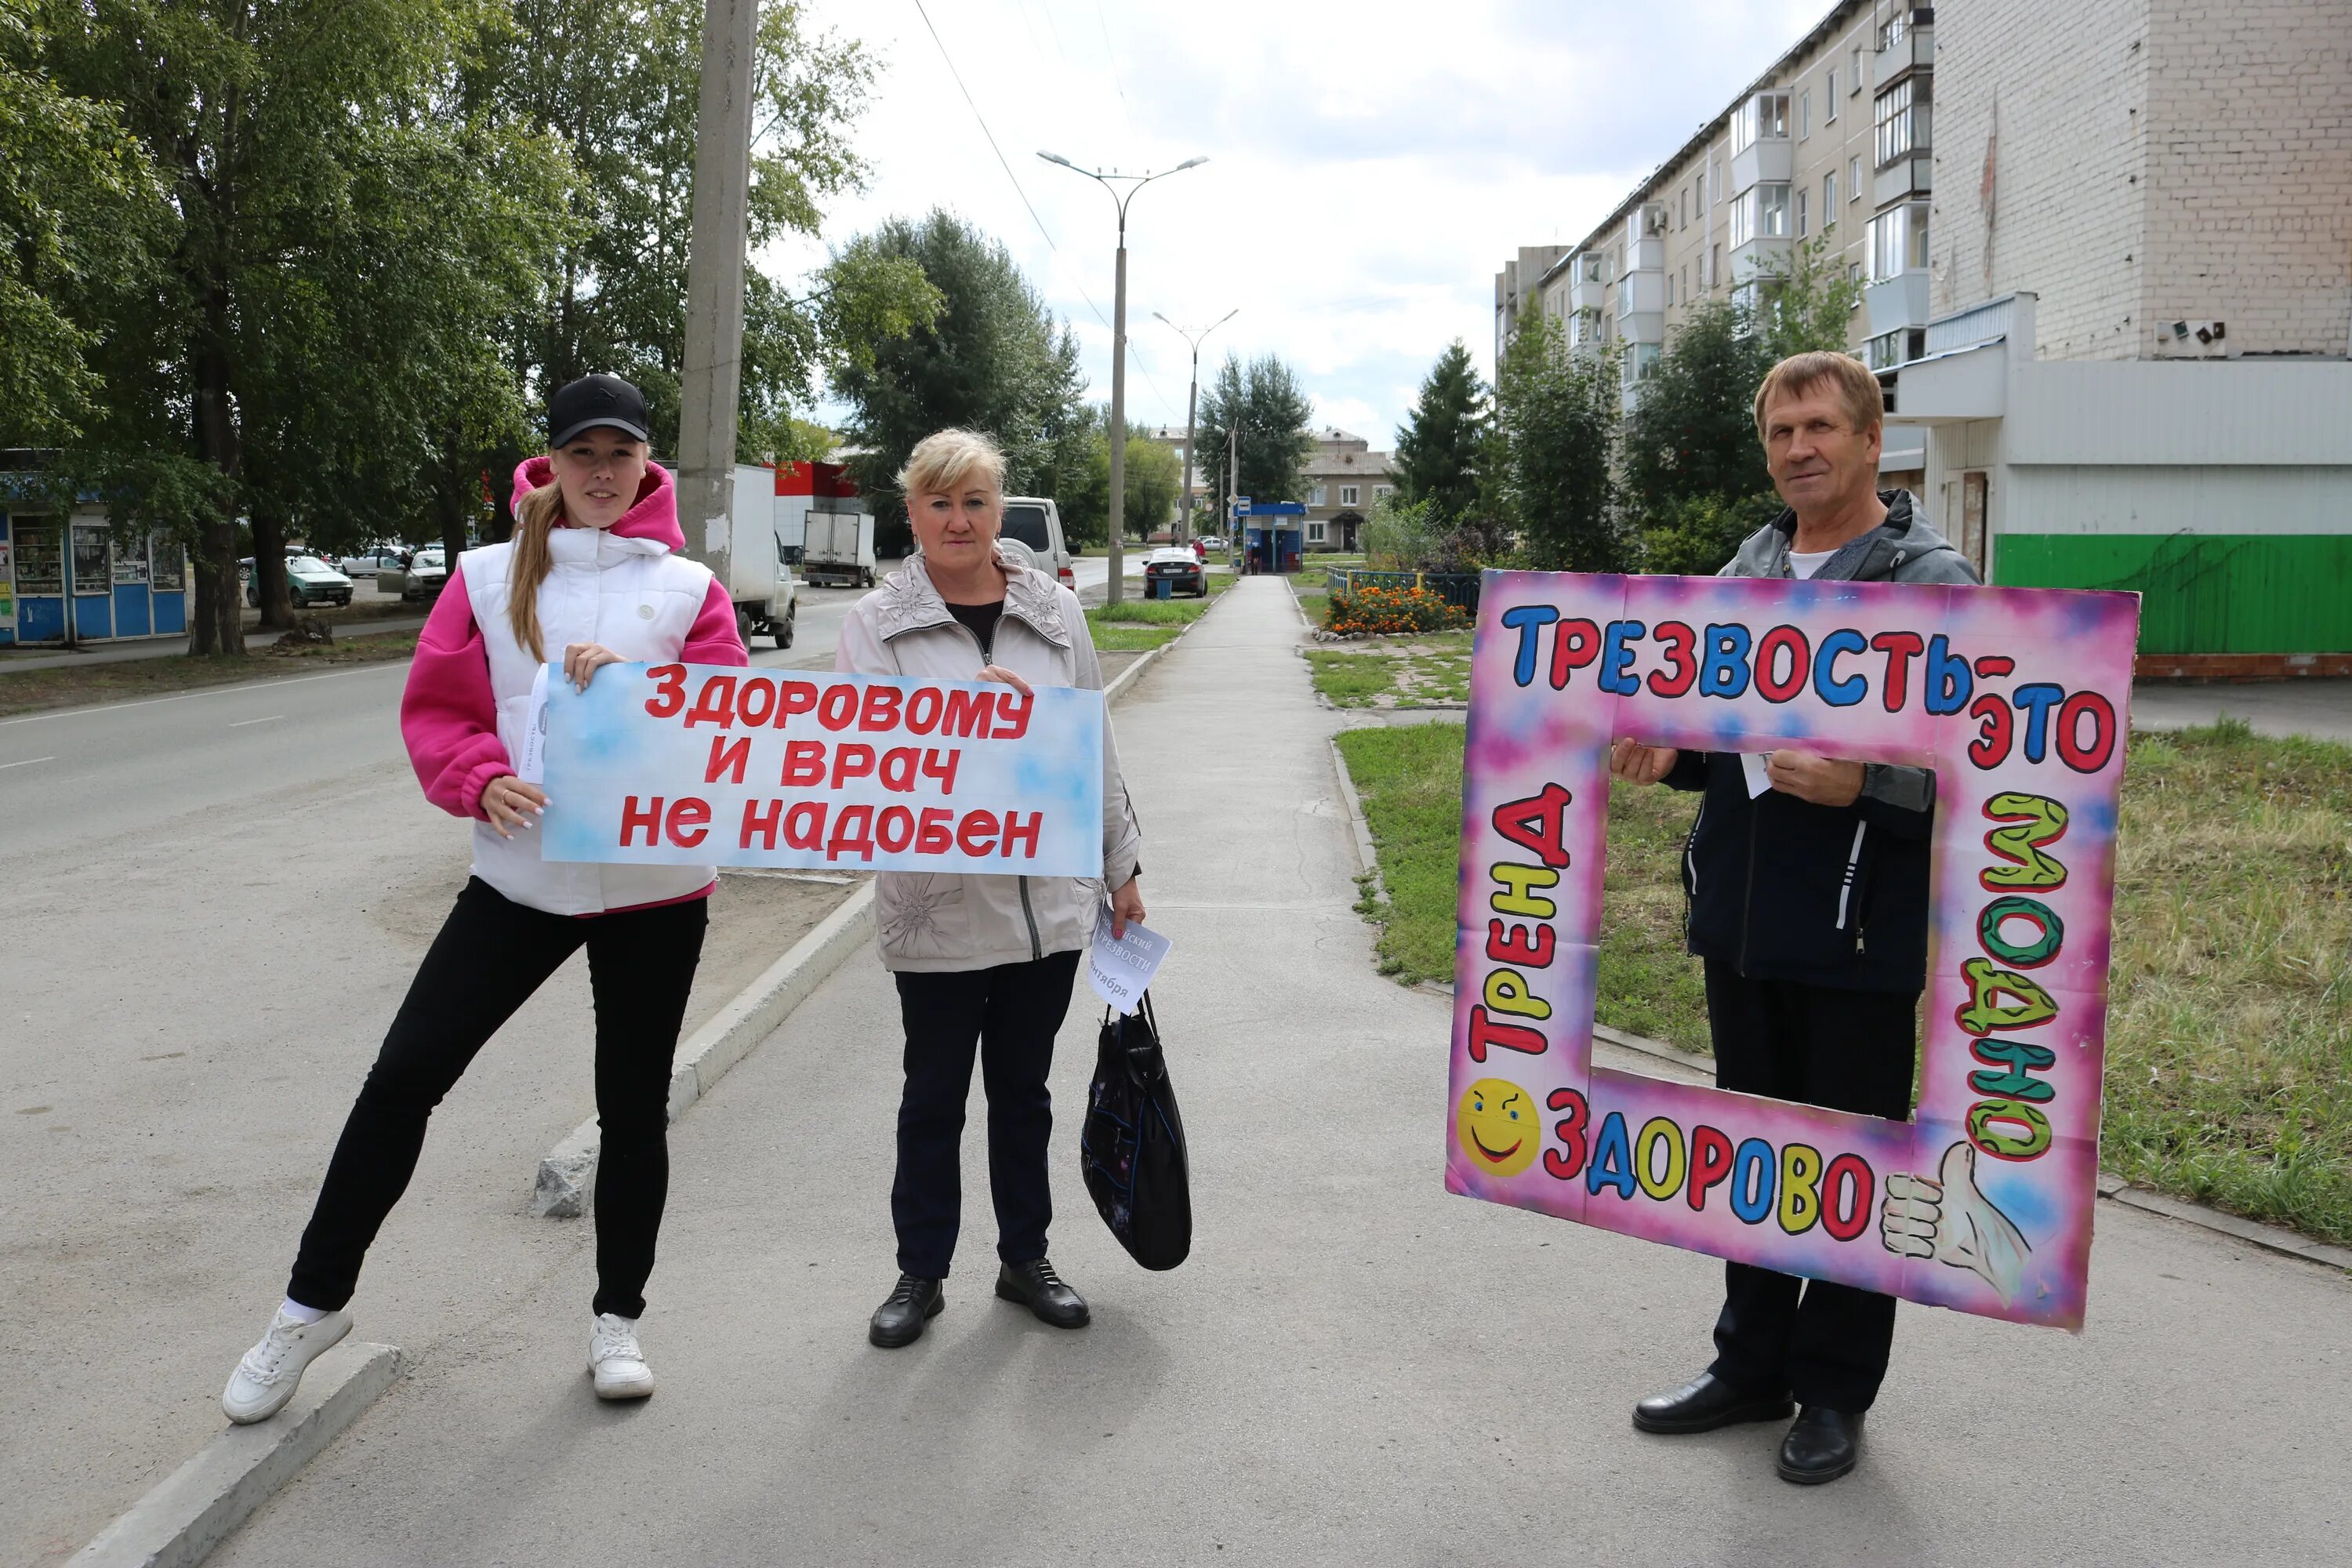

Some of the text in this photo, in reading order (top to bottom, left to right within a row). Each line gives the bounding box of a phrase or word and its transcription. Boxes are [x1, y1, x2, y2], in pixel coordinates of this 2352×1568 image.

[645, 664, 1034, 739] ЗДОРОВОМУ
[705, 735, 751, 784] И
[1098, 930, 1152, 972] ТРЕЗВОСТИ
[1468, 782, 1573, 1064] ТРЕНД
[1955, 790, 2070, 1163] МОДНО
[1542, 1087, 1876, 1243] ЗДОРОВО
